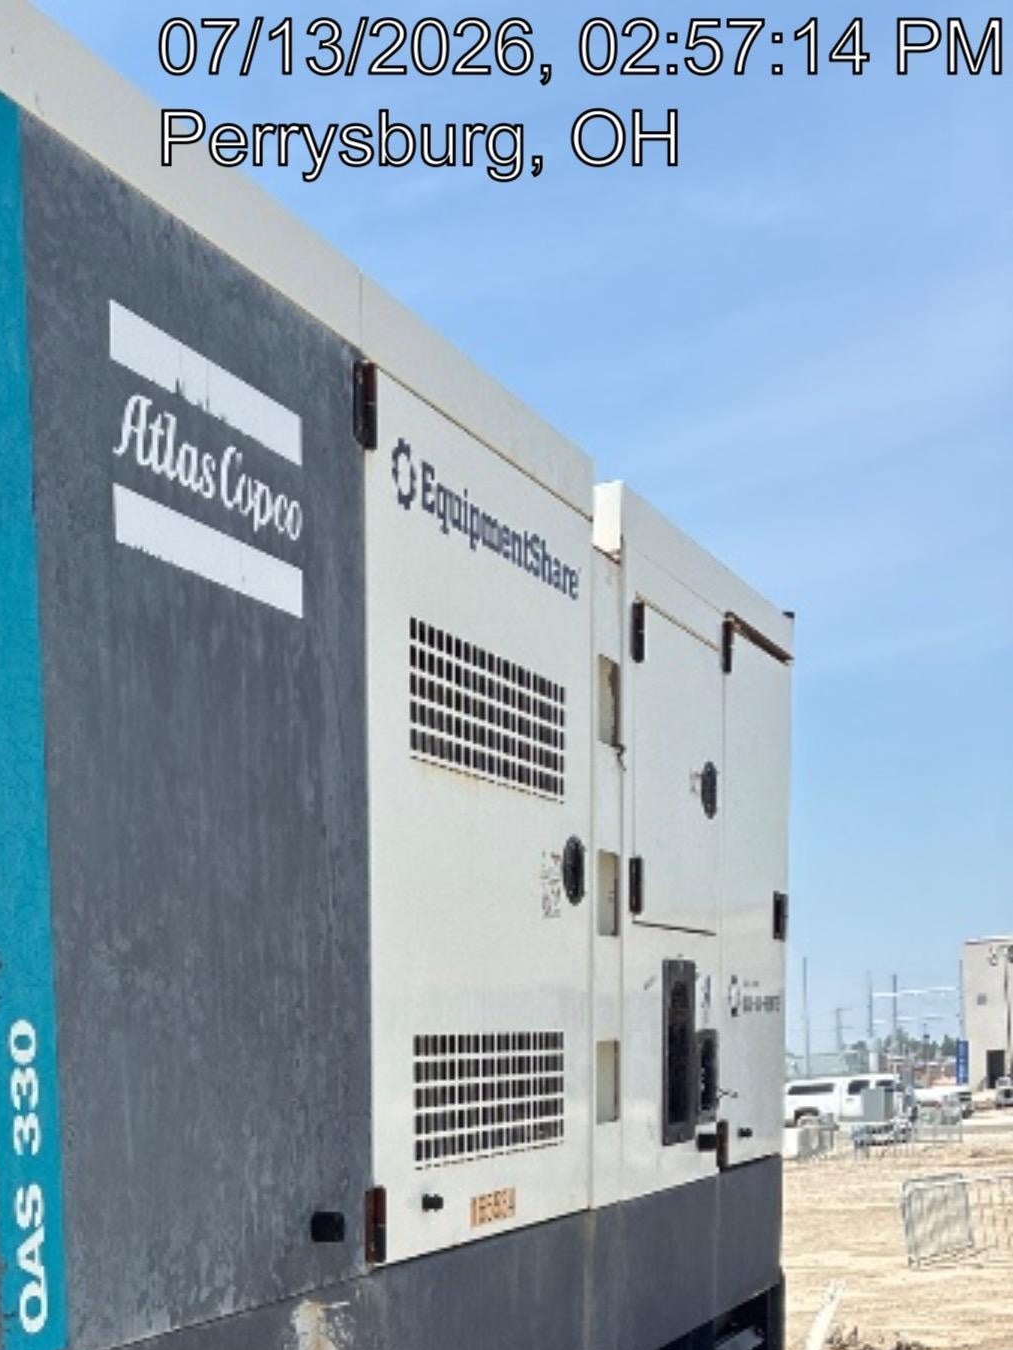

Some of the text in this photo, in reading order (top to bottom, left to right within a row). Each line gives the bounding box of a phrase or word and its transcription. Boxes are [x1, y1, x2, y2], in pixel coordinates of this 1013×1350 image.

[112, 394, 304, 543] Atlas Copco
[421, 460, 580, 600] EquipmentShare
[8, 1018, 49, 1336] QAS 330
